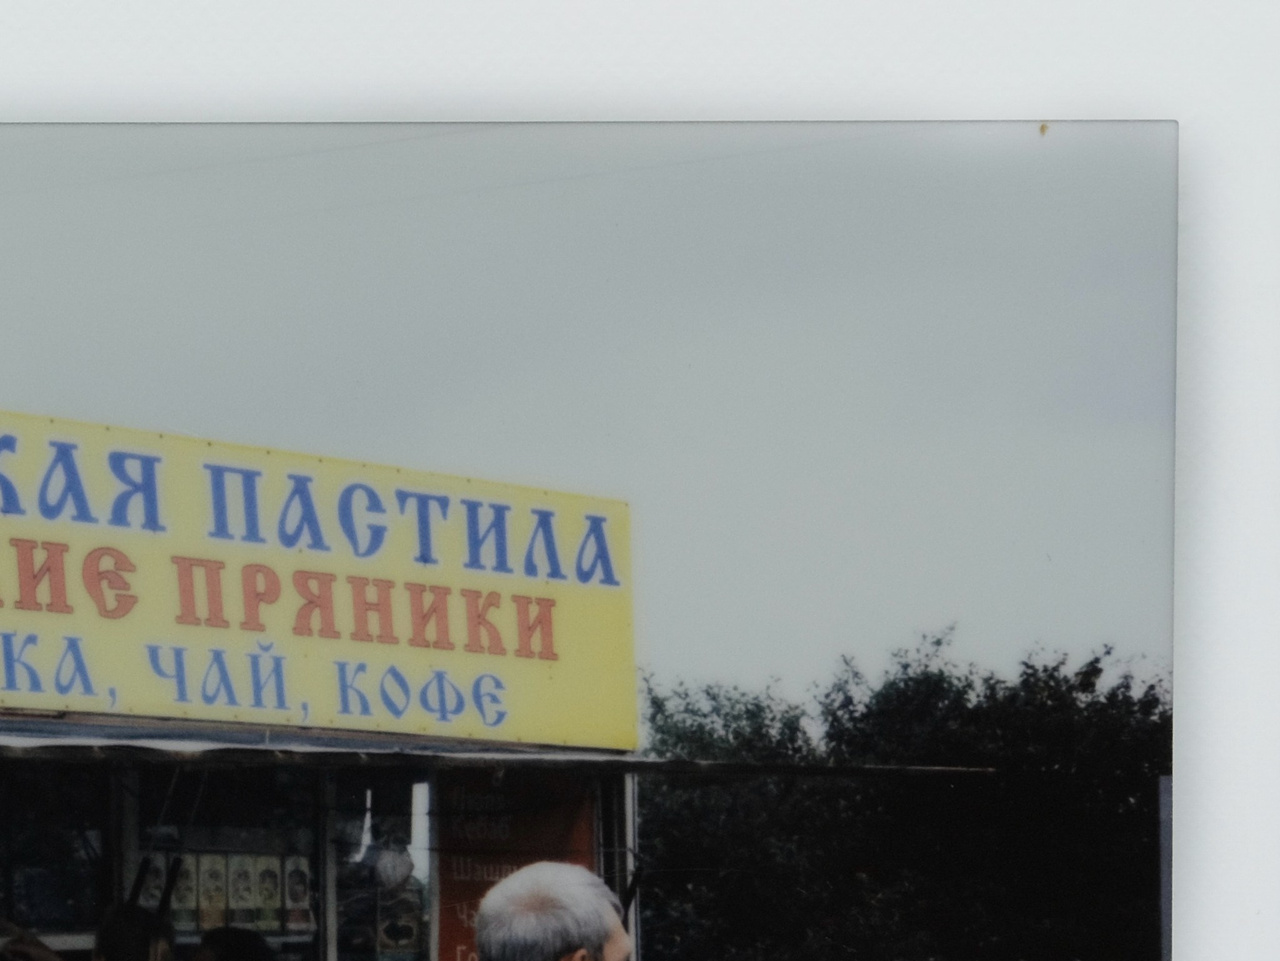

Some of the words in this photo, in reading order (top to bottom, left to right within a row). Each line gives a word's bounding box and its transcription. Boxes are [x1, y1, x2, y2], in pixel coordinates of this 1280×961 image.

[203, 463, 620, 586] ПАСТИЛА
[171, 556, 559, 661] ПРЯНИКИ
[146, 641, 309, 721] ЧАЙ,
[334, 660, 508, 727] КОФЕ
